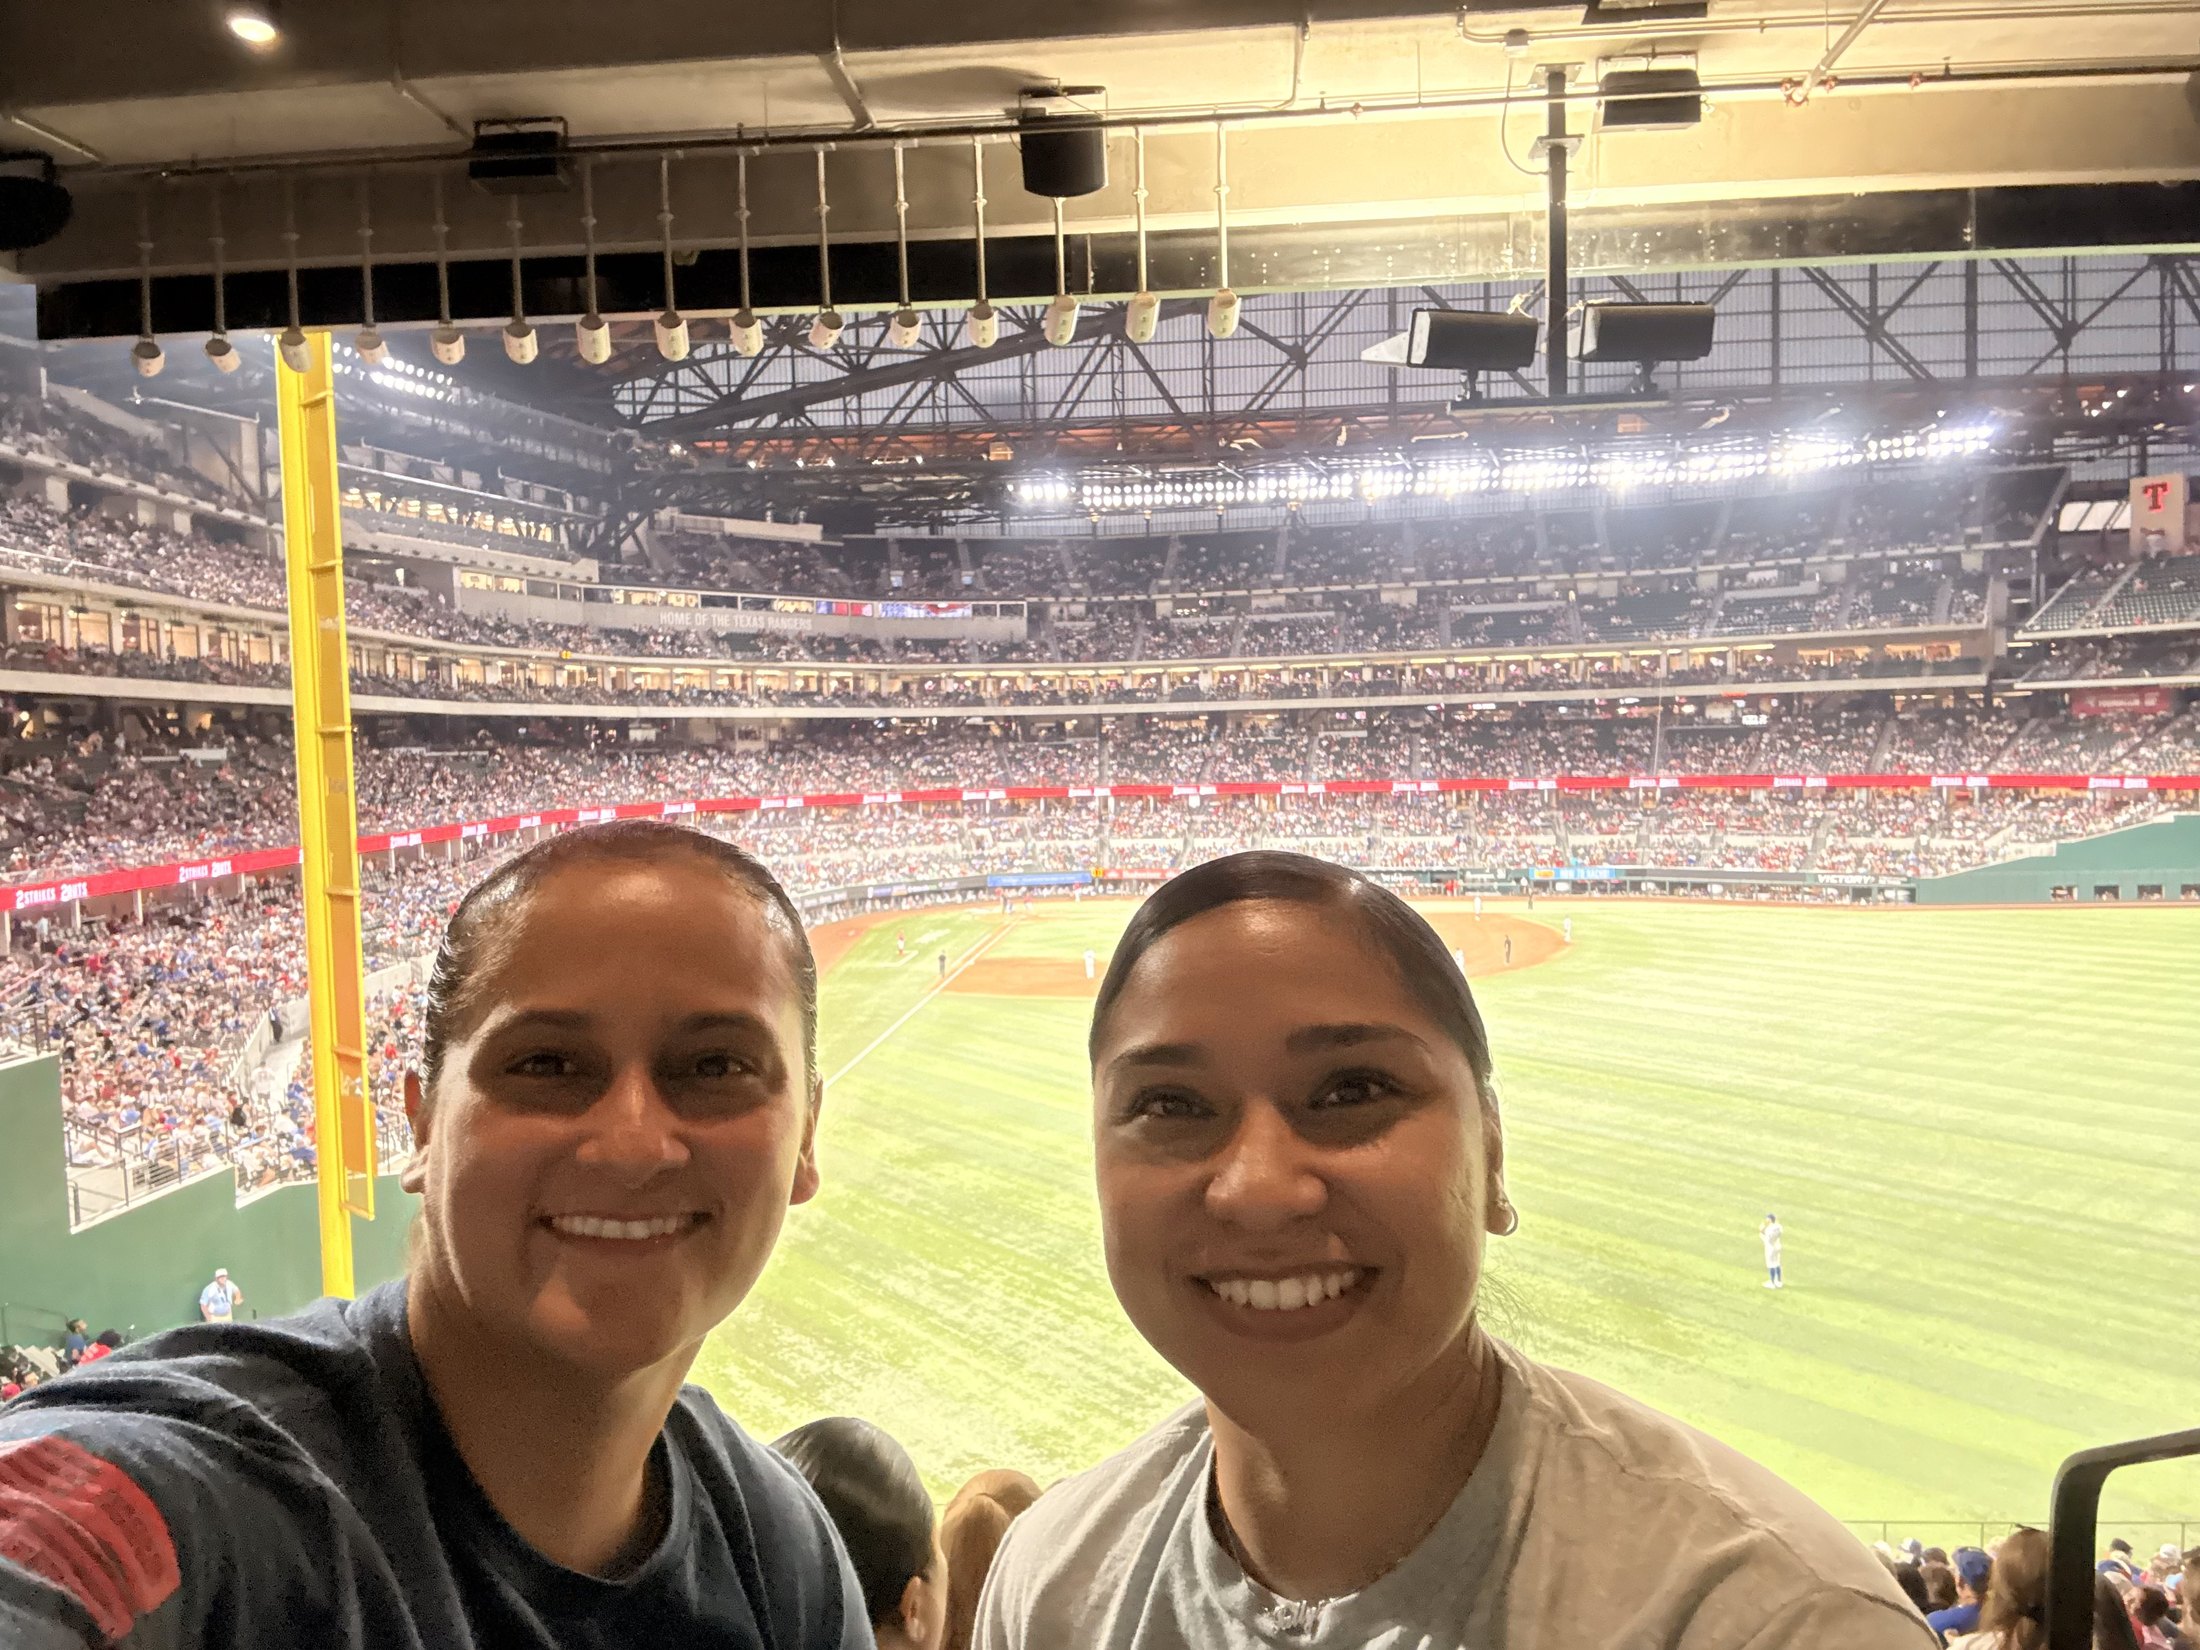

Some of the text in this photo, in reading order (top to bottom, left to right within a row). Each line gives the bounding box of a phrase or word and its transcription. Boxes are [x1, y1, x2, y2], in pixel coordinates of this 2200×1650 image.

[2142, 482, 2170, 511] T
[660, 611, 813, 631] HOME OF THE TEXAS RANGERS
